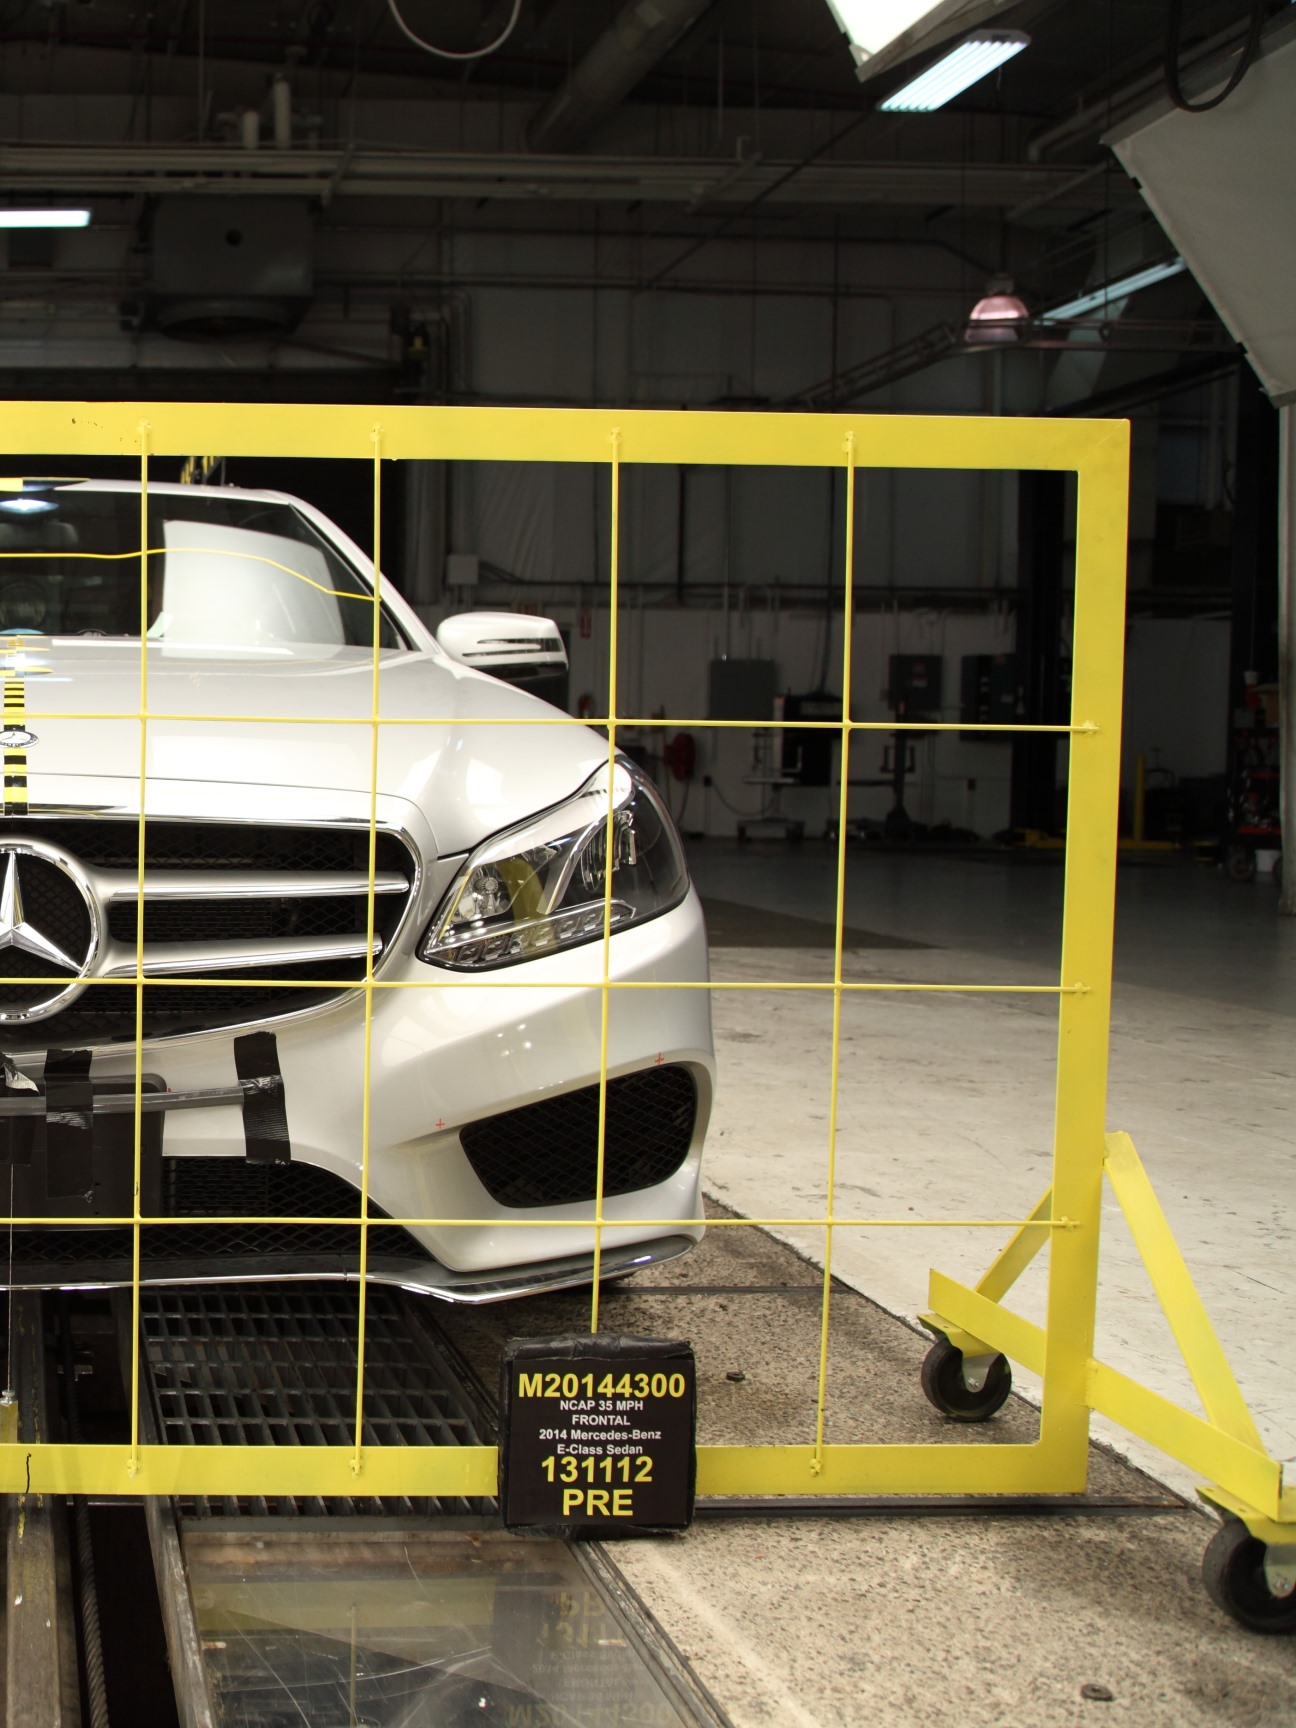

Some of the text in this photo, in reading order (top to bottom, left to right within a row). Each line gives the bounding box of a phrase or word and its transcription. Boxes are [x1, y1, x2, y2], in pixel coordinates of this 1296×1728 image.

[518, 1373, 685, 1398] M20144300
[560, 1400, 644, 1411] NCAP 35 MPH
[572, 1415, 631, 1425] FRONTAL
[539, 1429, 661, 1440] 2014 Mercedes-Benz
[557, 1444, 643, 1454] E-Class Sedan
[541, 1456, 653, 1482] 131112
[562, 1489, 634, 1516] PRE
